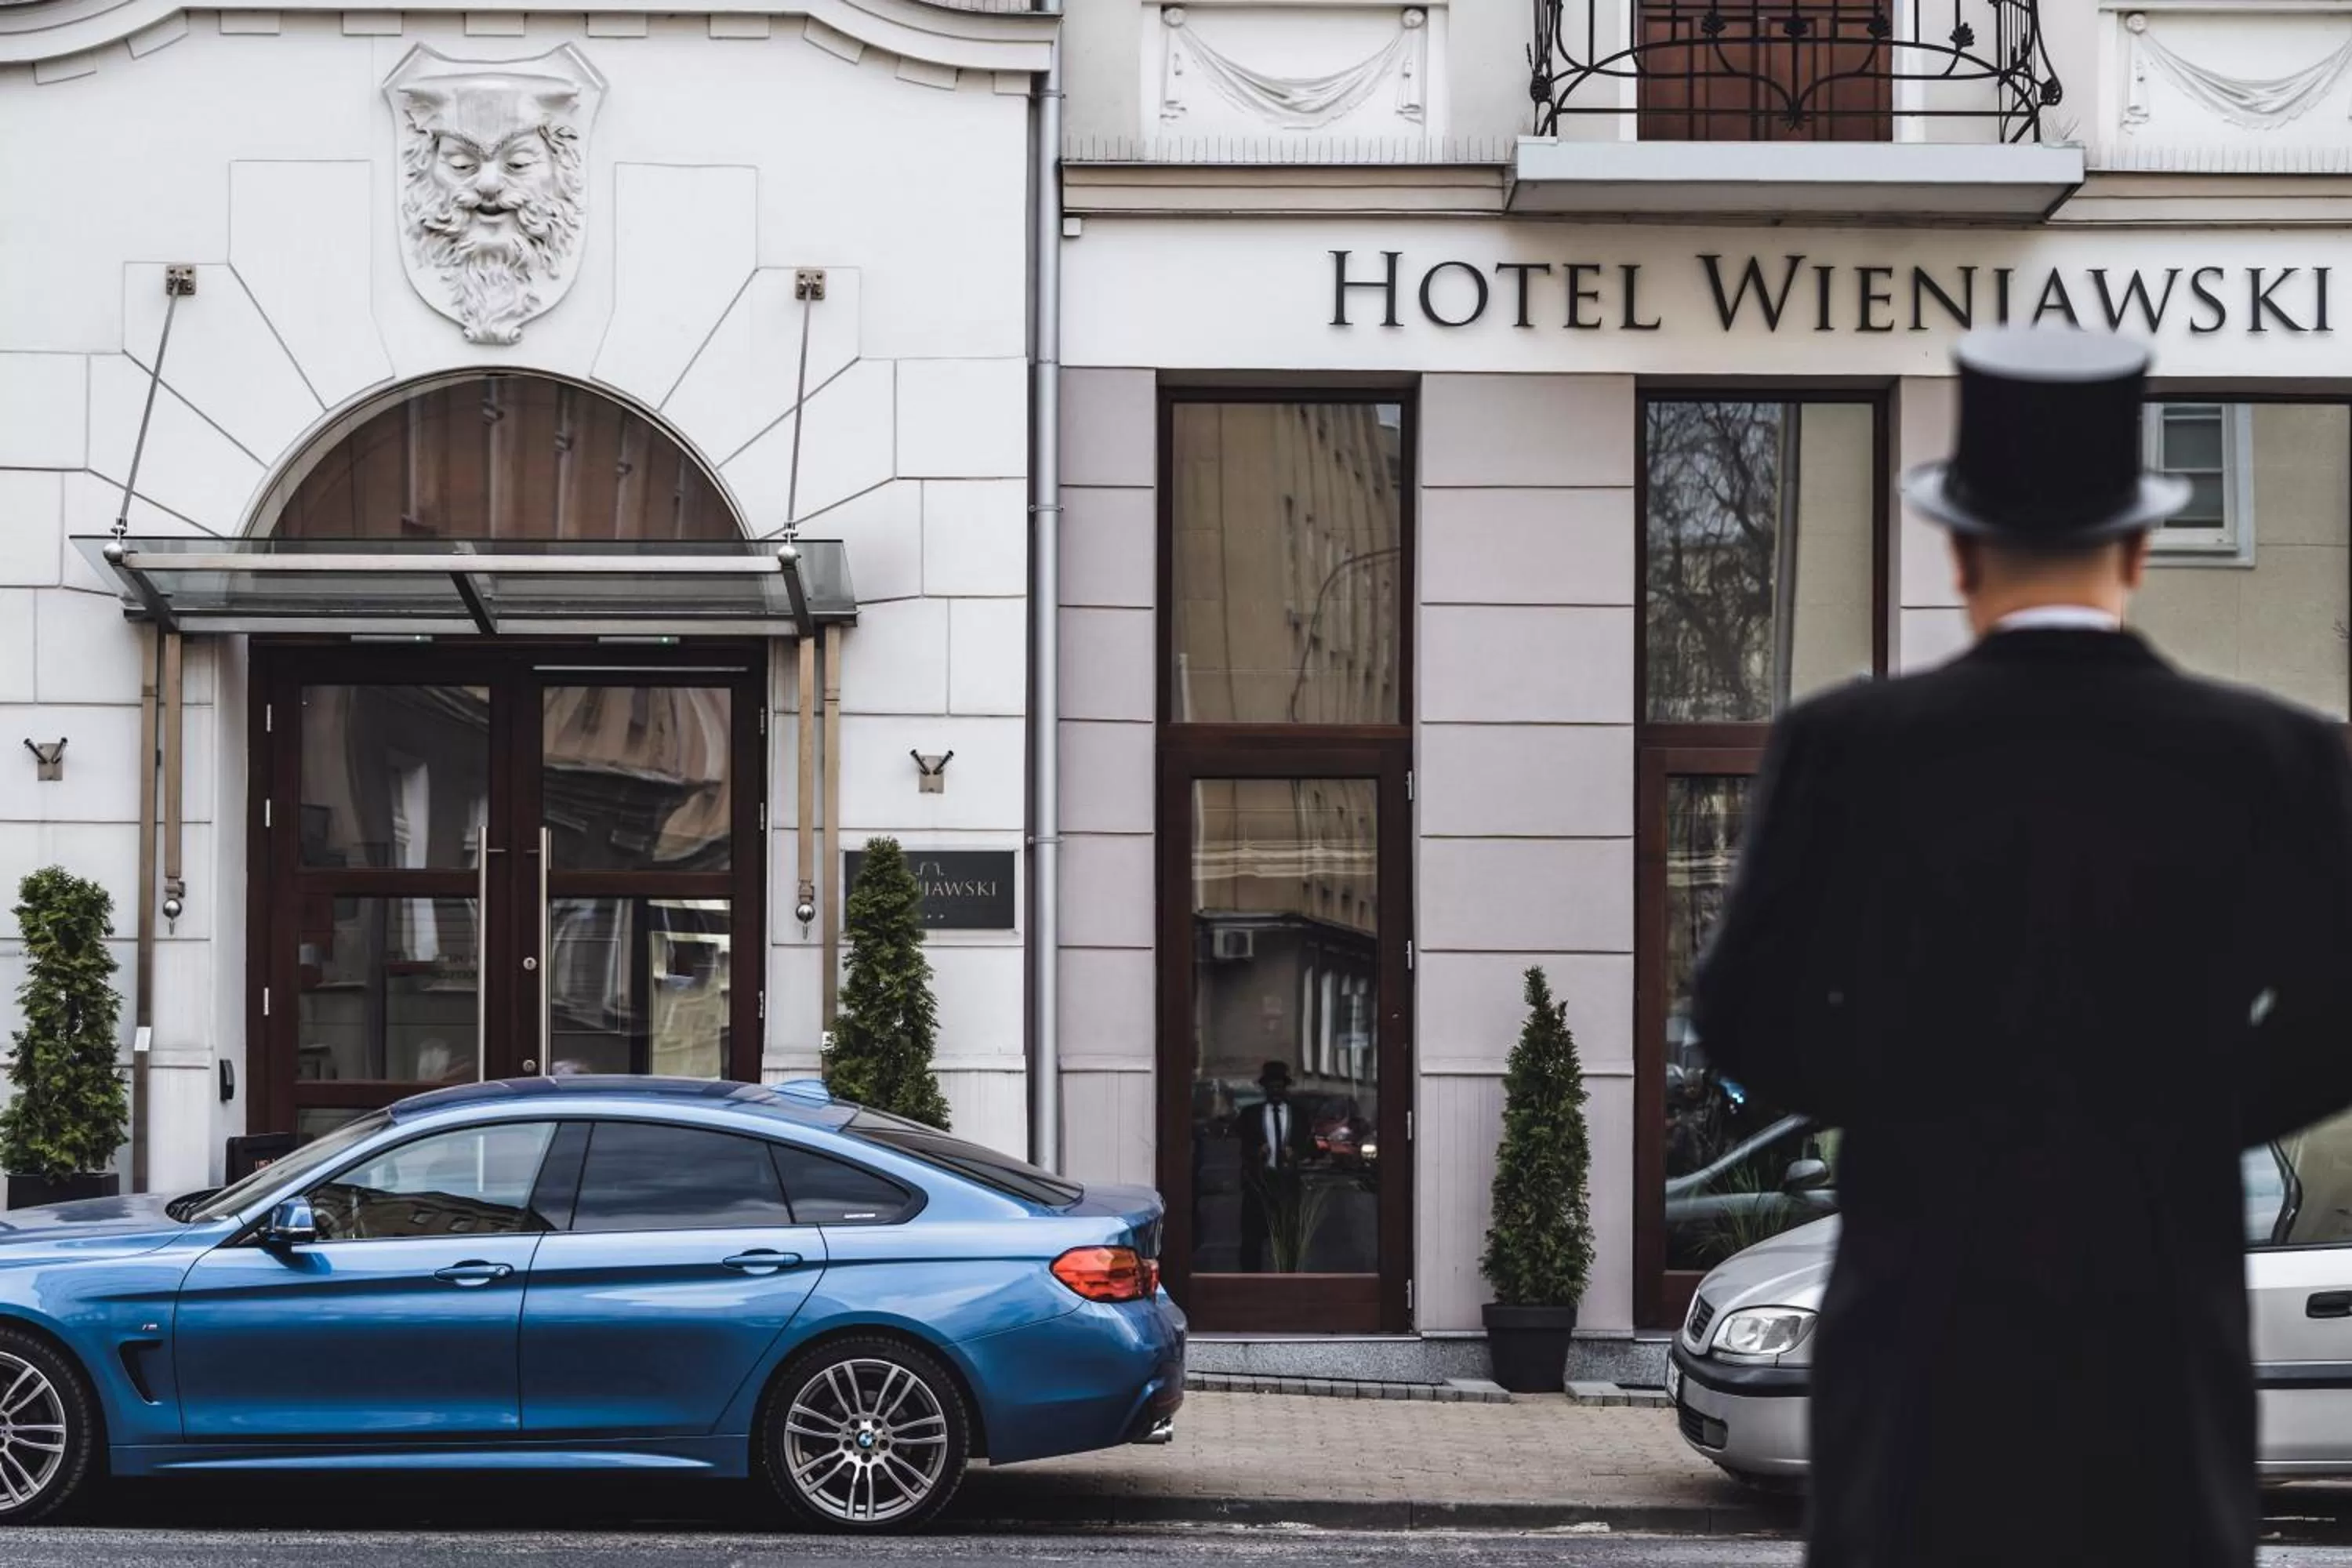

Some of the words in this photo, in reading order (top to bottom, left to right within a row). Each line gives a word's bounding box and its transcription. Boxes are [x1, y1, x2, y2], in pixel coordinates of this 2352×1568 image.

[1327, 249, 1662, 331] HOTEL
[1695, 253, 2334, 334] WIENIAWSKI
[918, 880, 996, 897] IAWSKI
